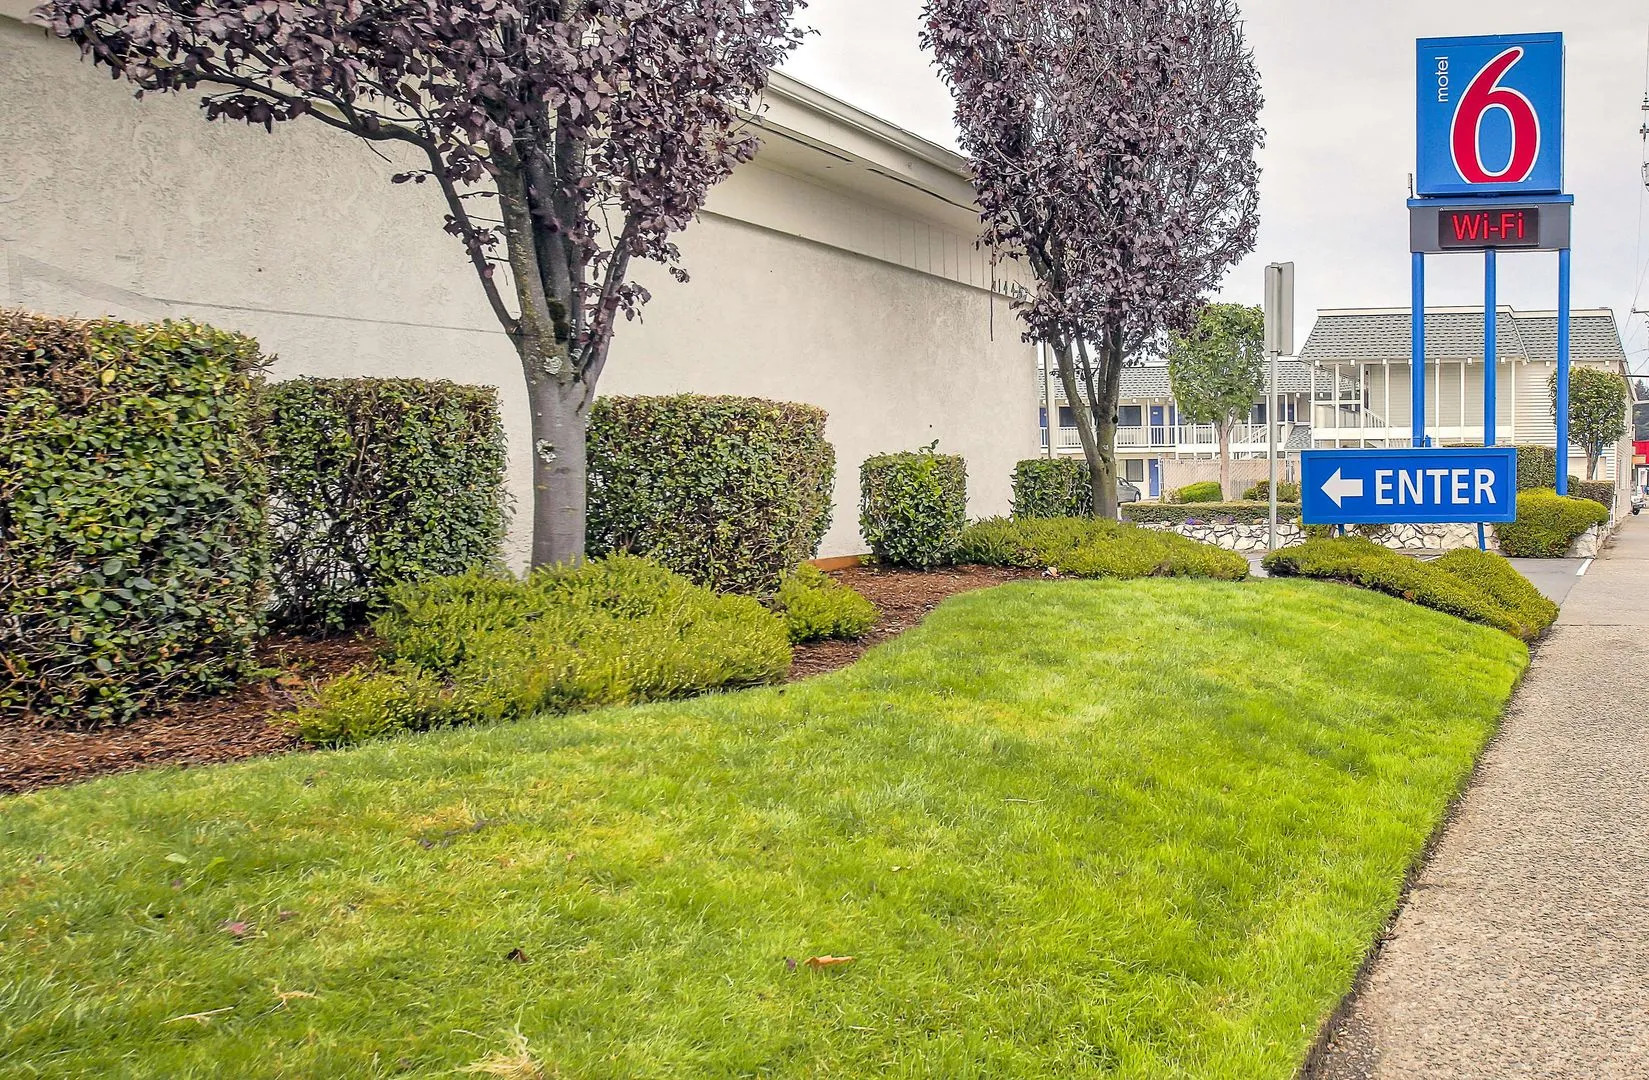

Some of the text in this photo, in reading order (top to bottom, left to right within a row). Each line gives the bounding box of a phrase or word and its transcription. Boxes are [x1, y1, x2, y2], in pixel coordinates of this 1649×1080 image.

[1435, 56, 1449, 102] motel
[1450, 46, 1541, 184] 6
[1452, 212, 1525, 240] Wi-Fi
[1375, 469, 1496, 505] ENTER
